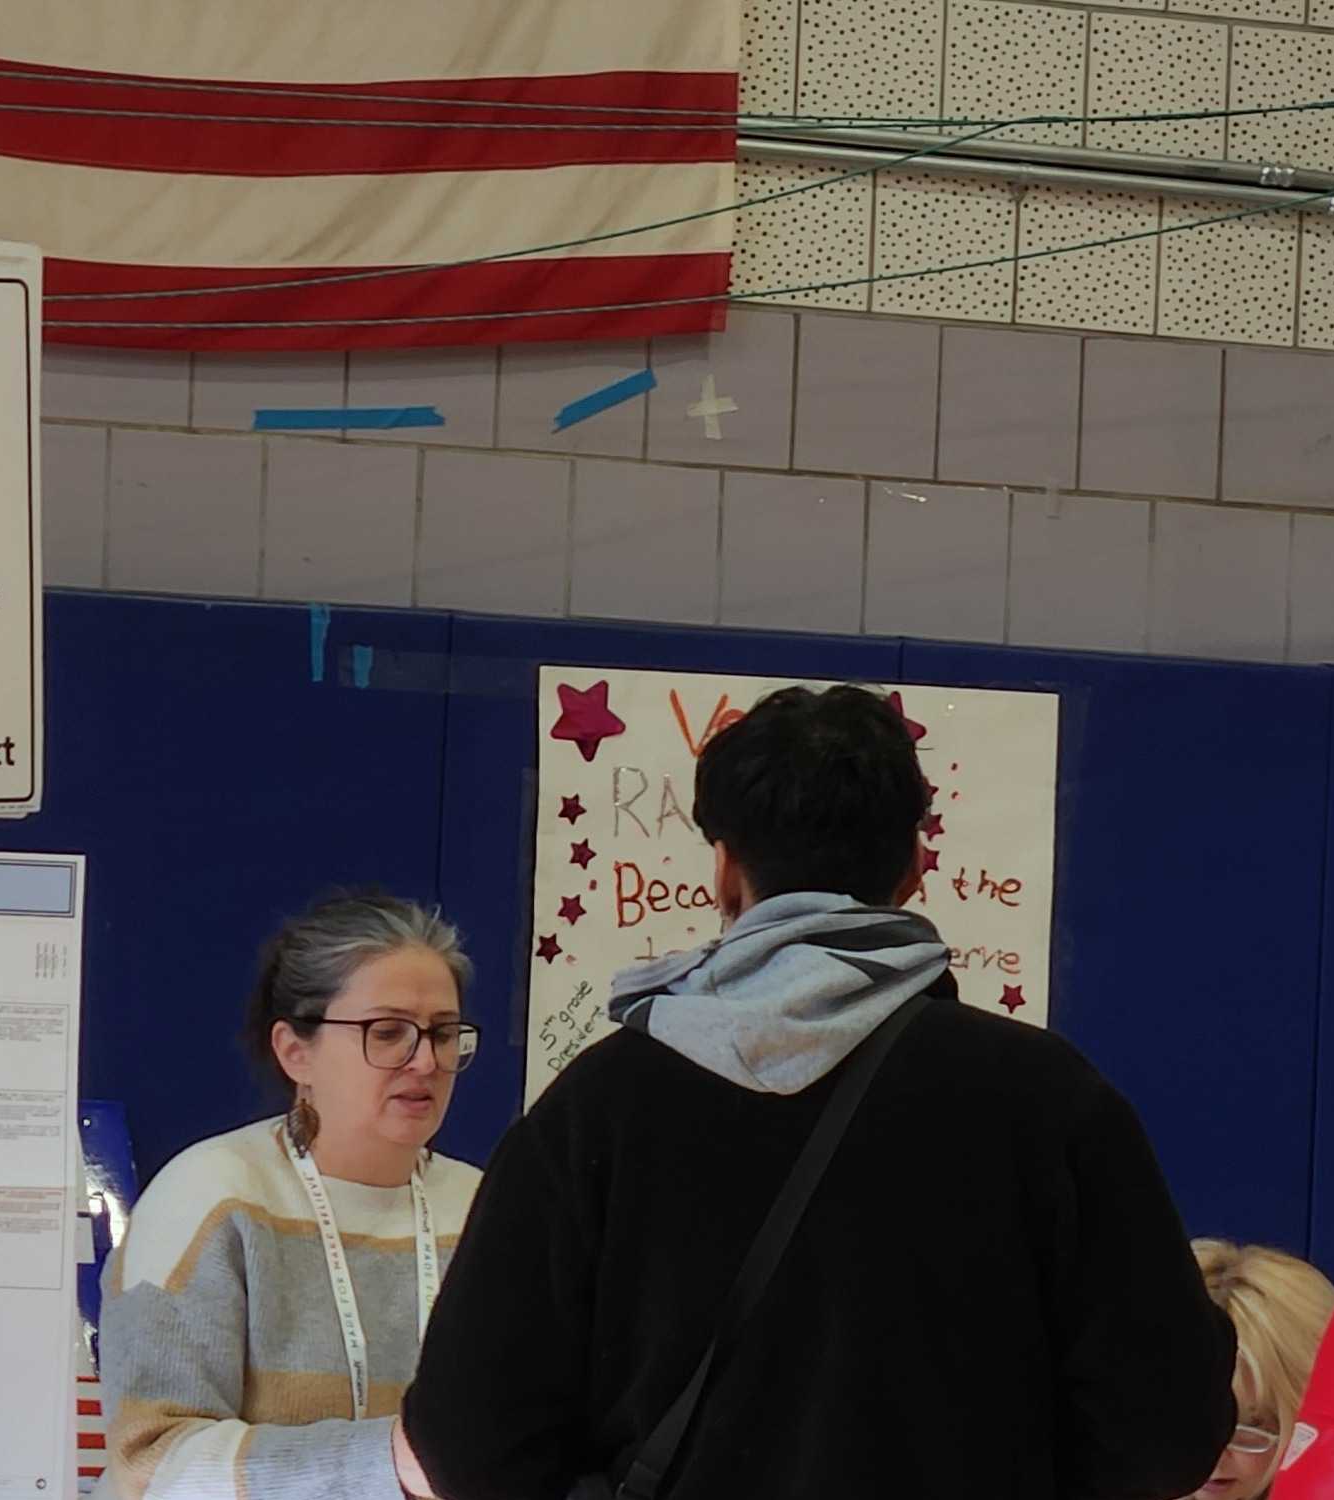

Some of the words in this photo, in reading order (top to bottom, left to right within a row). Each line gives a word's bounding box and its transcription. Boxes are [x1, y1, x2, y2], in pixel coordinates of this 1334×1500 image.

[613, 861, 720, 929] Beca
[952, 866, 1022, 907] the
[947, 945, 1021, 975] erve
